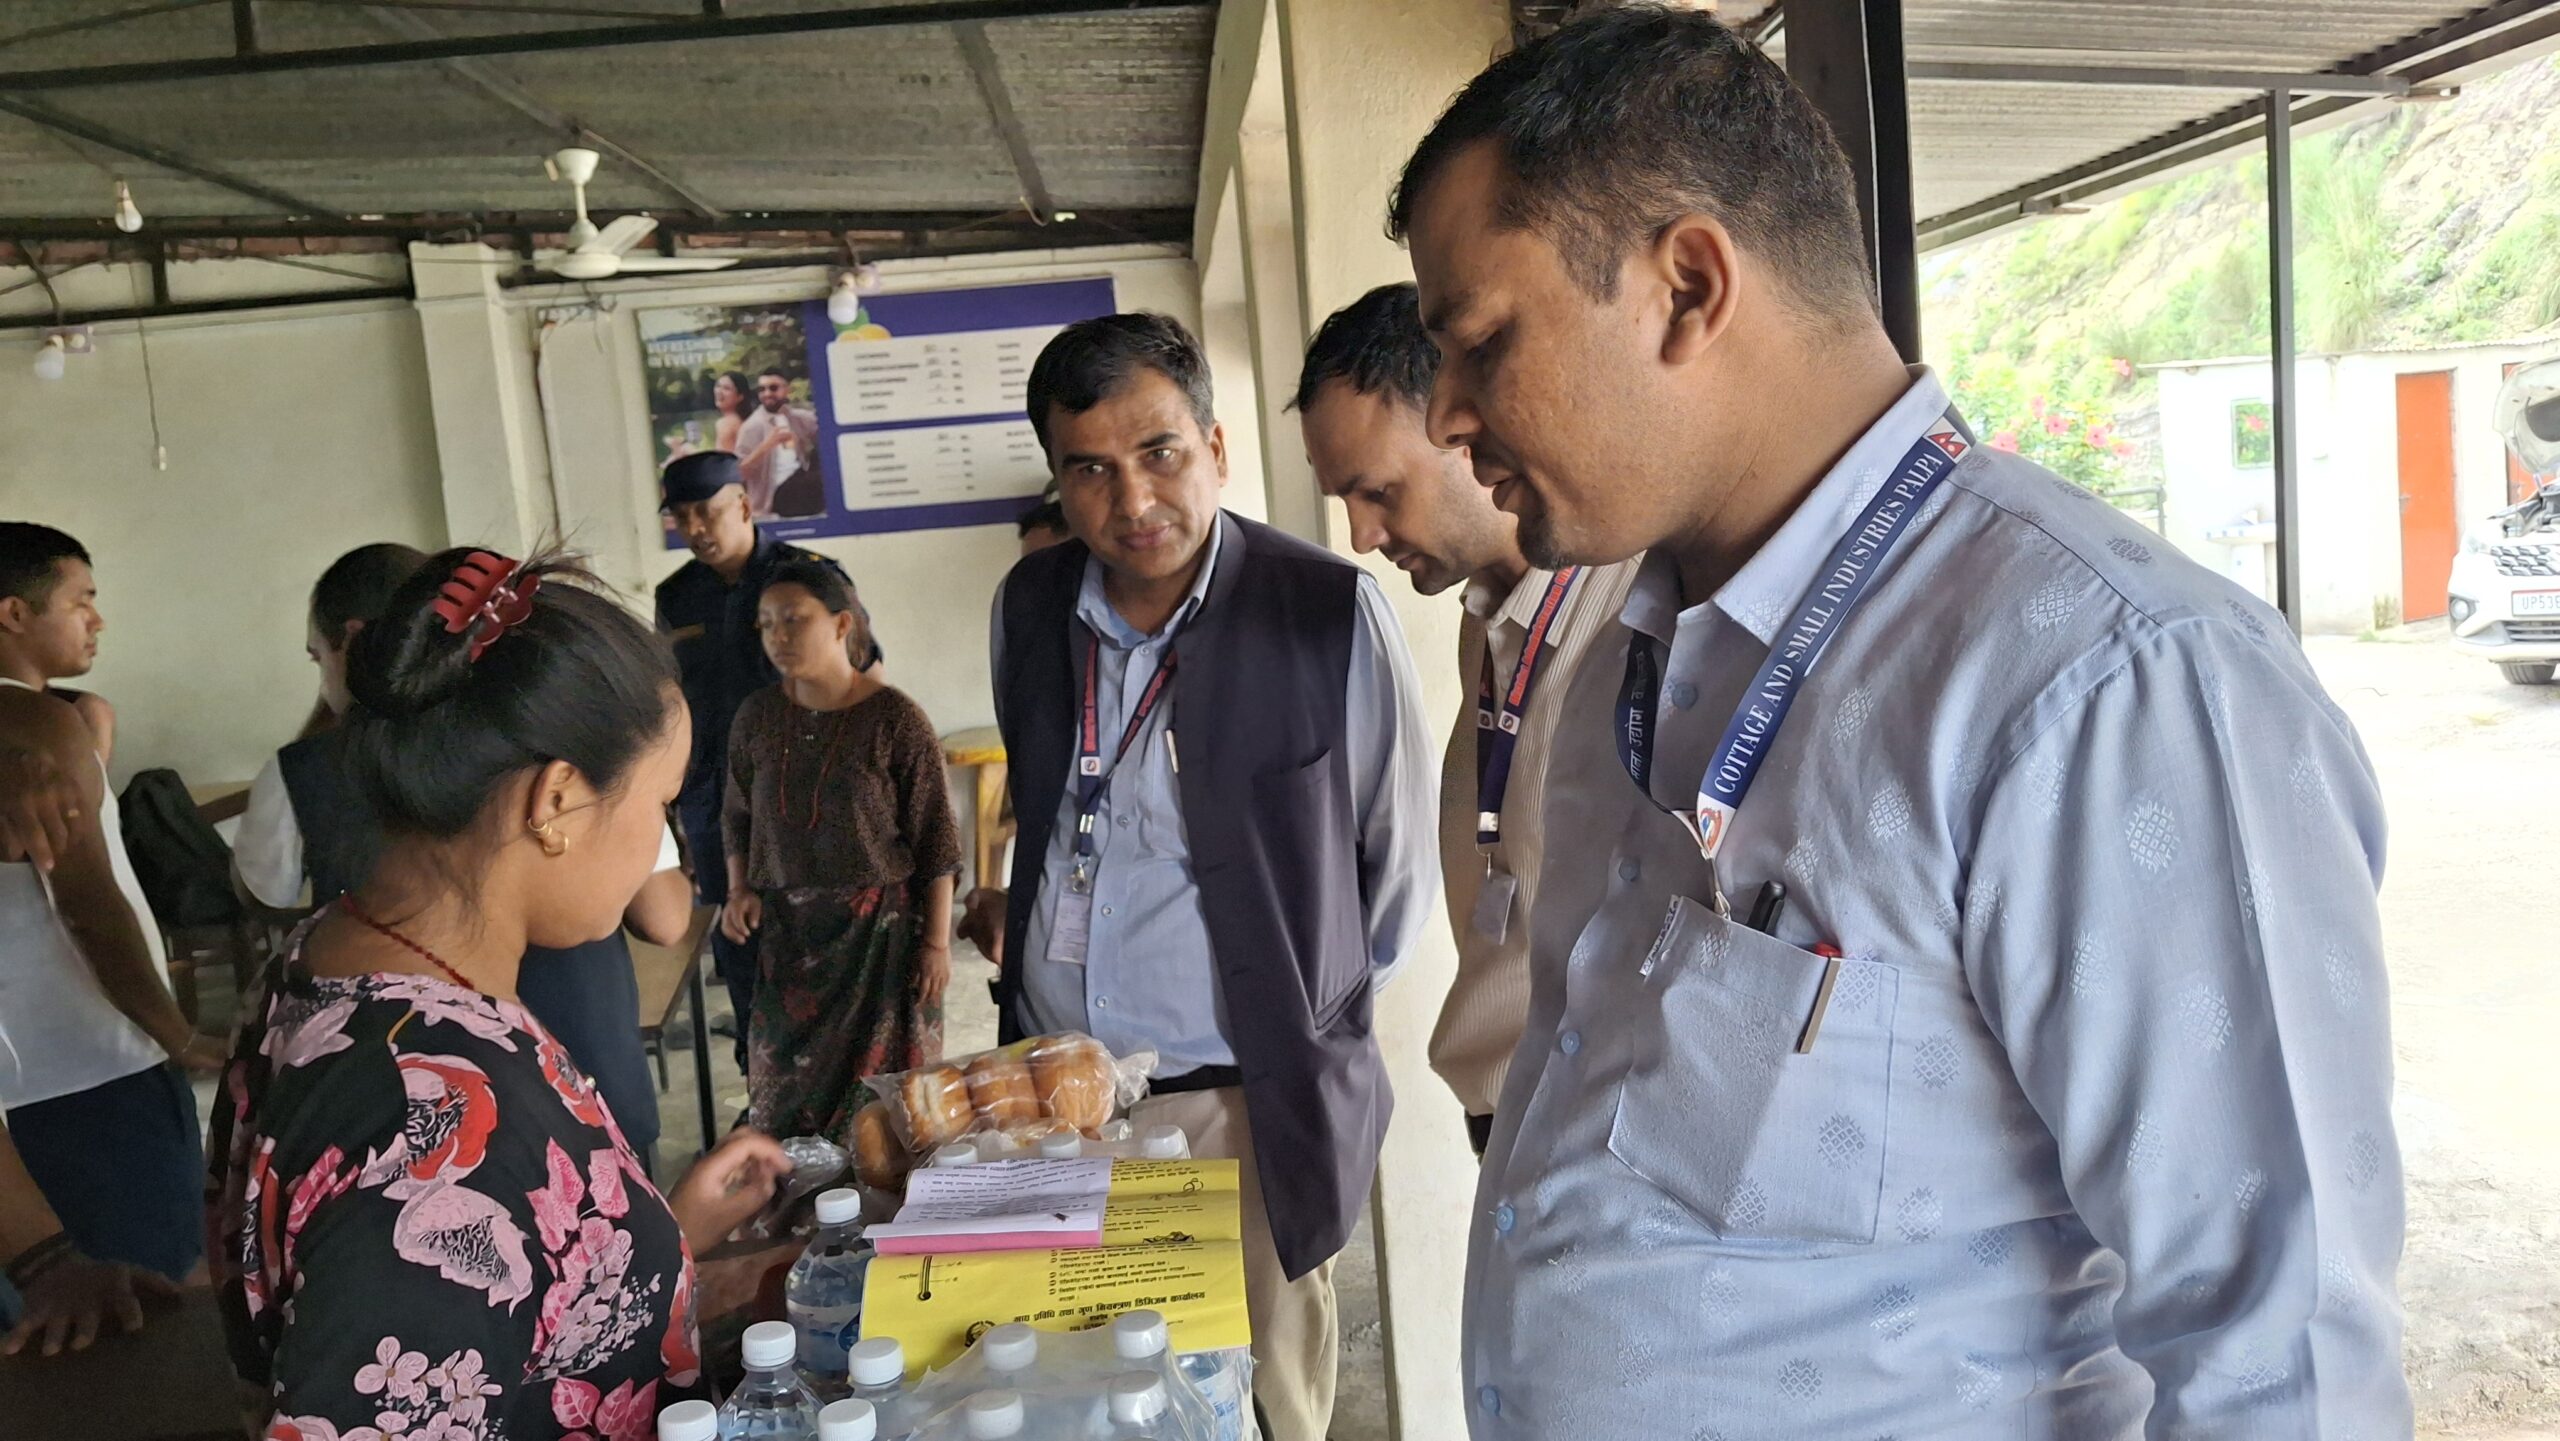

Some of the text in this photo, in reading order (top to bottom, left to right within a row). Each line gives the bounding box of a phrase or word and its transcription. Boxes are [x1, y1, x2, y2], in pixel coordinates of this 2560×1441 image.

[1713, 453, 1943, 794] COTTAGE AND SMALL INDUSTRIES PALPA
[1624, 707, 1645, 748] उद्योग
